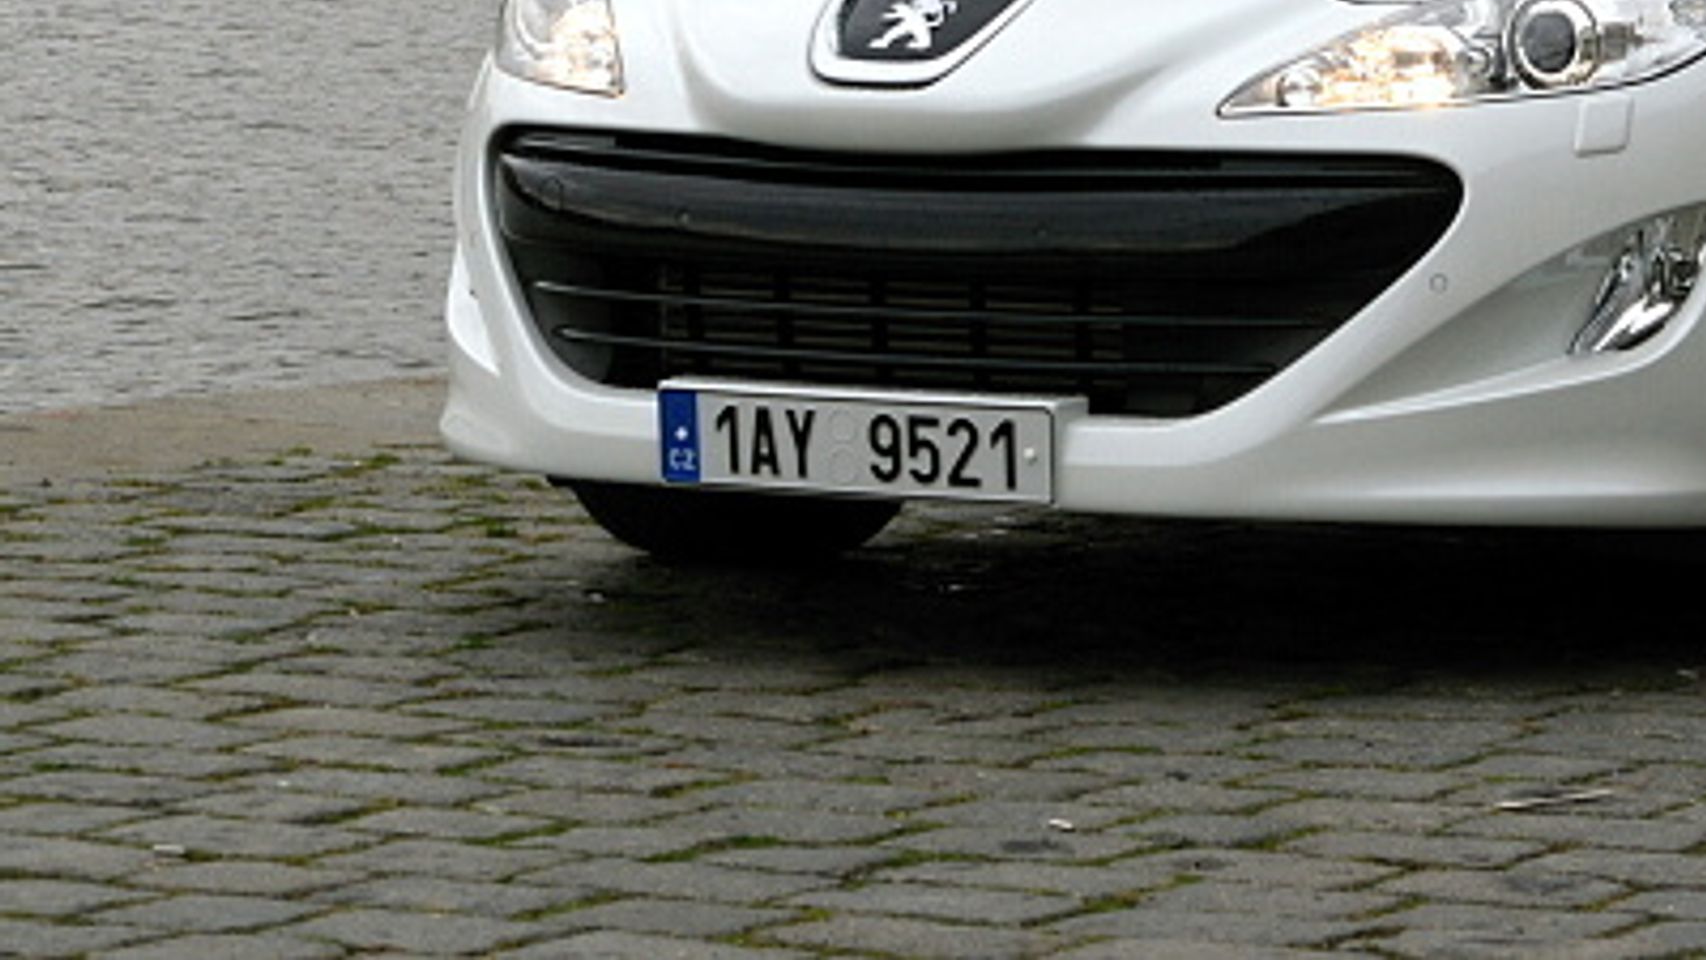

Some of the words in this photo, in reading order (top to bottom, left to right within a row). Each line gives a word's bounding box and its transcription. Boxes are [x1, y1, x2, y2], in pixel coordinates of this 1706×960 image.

[669, 447, 696, 471] CZ
[715, 405, 816, 478] 1AY
[868, 413, 1018, 490] 9521
